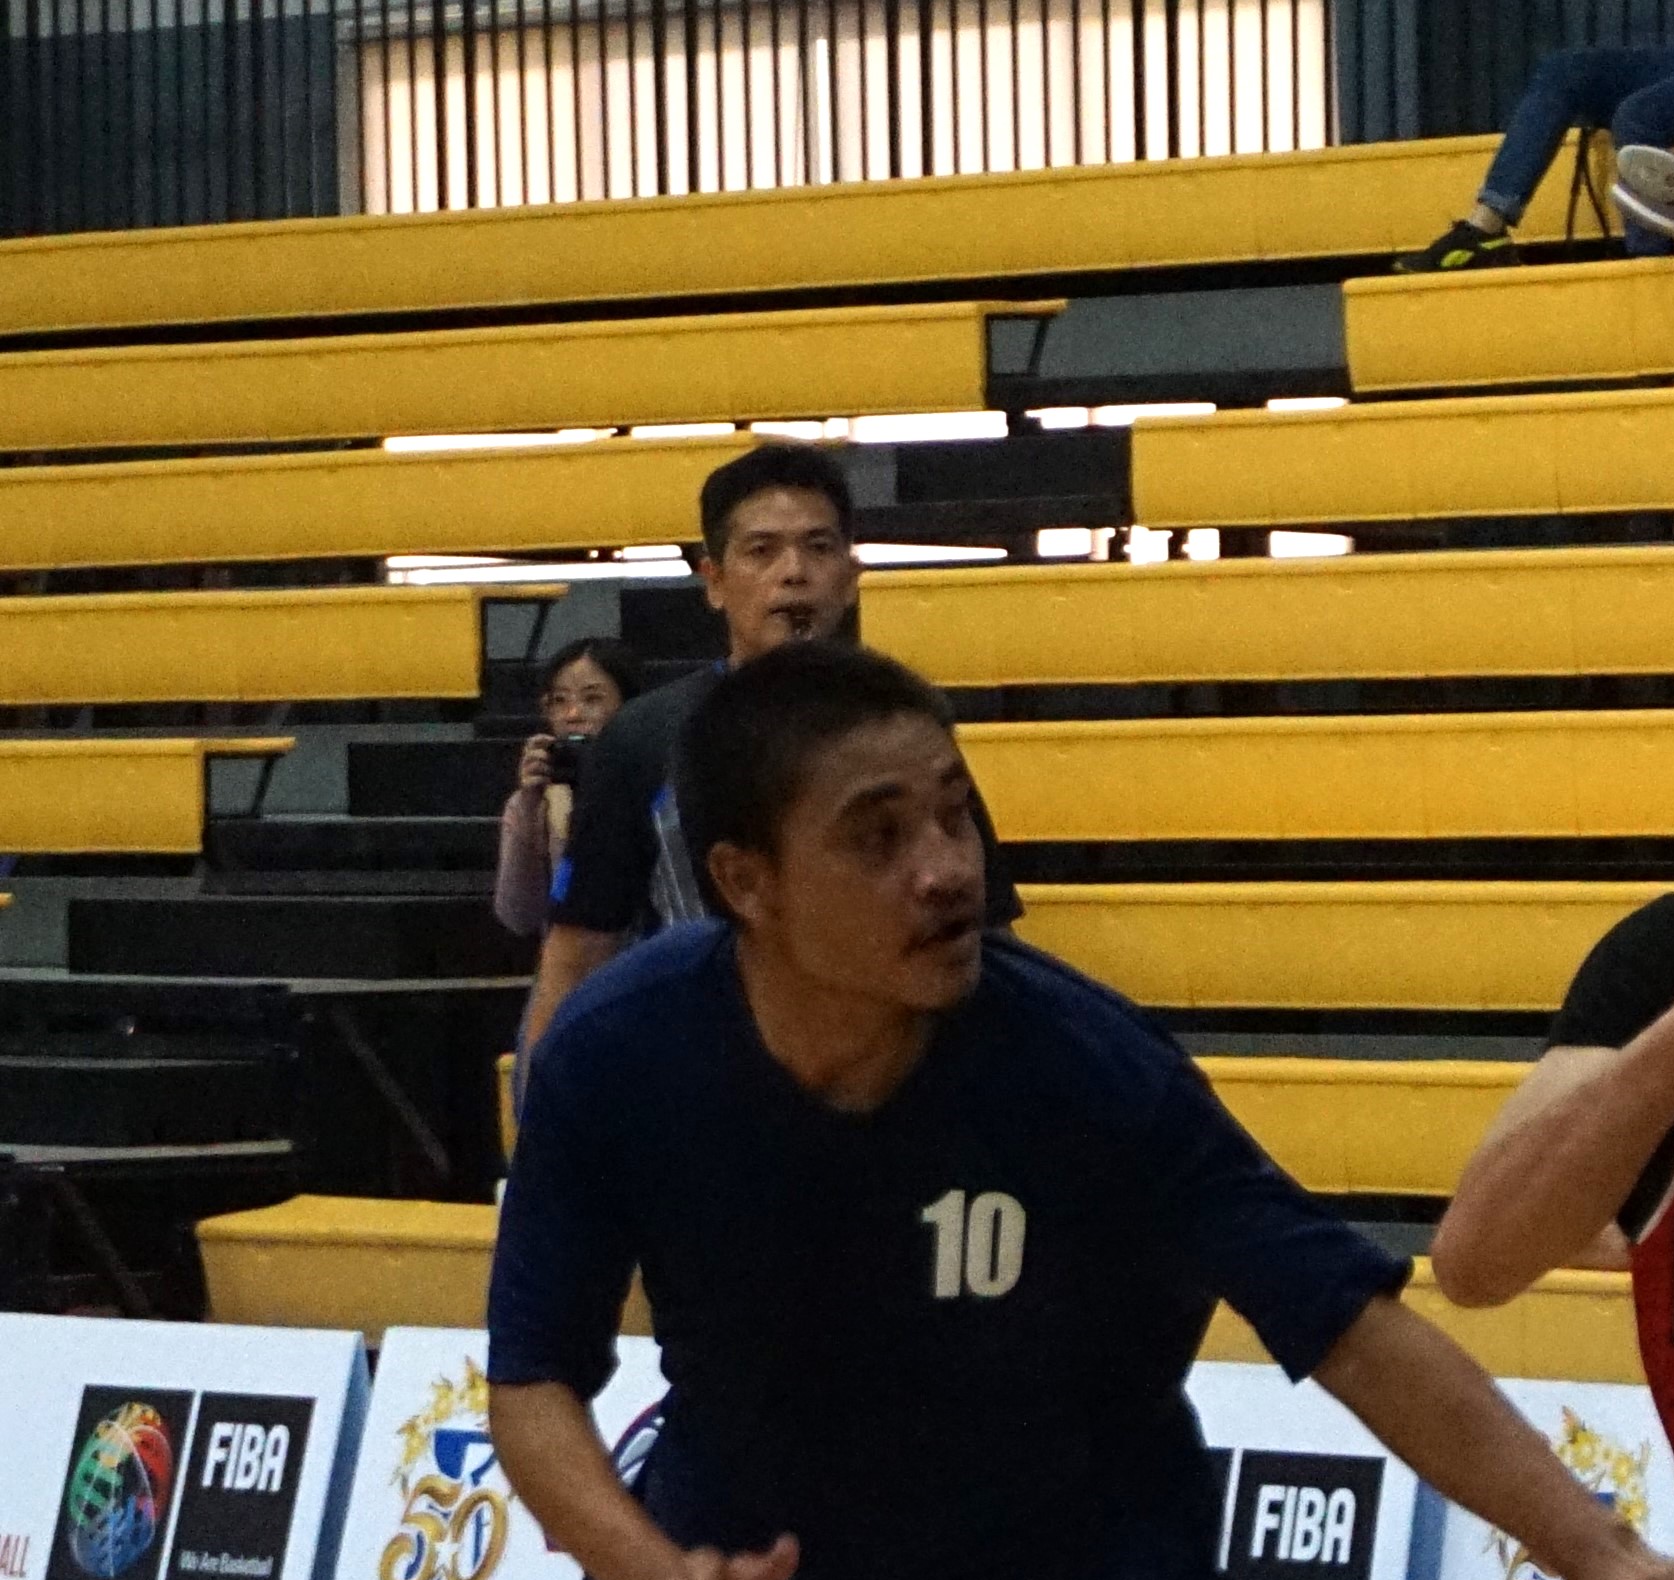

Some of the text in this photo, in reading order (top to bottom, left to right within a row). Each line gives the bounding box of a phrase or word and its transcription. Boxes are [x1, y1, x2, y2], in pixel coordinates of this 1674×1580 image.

[922, 1189, 1027, 1298] 10
[202, 1421, 290, 1492] FIBA
[0, 1533, 30, 1578] ALL
[1250, 1484, 1357, 1564] FIBA
